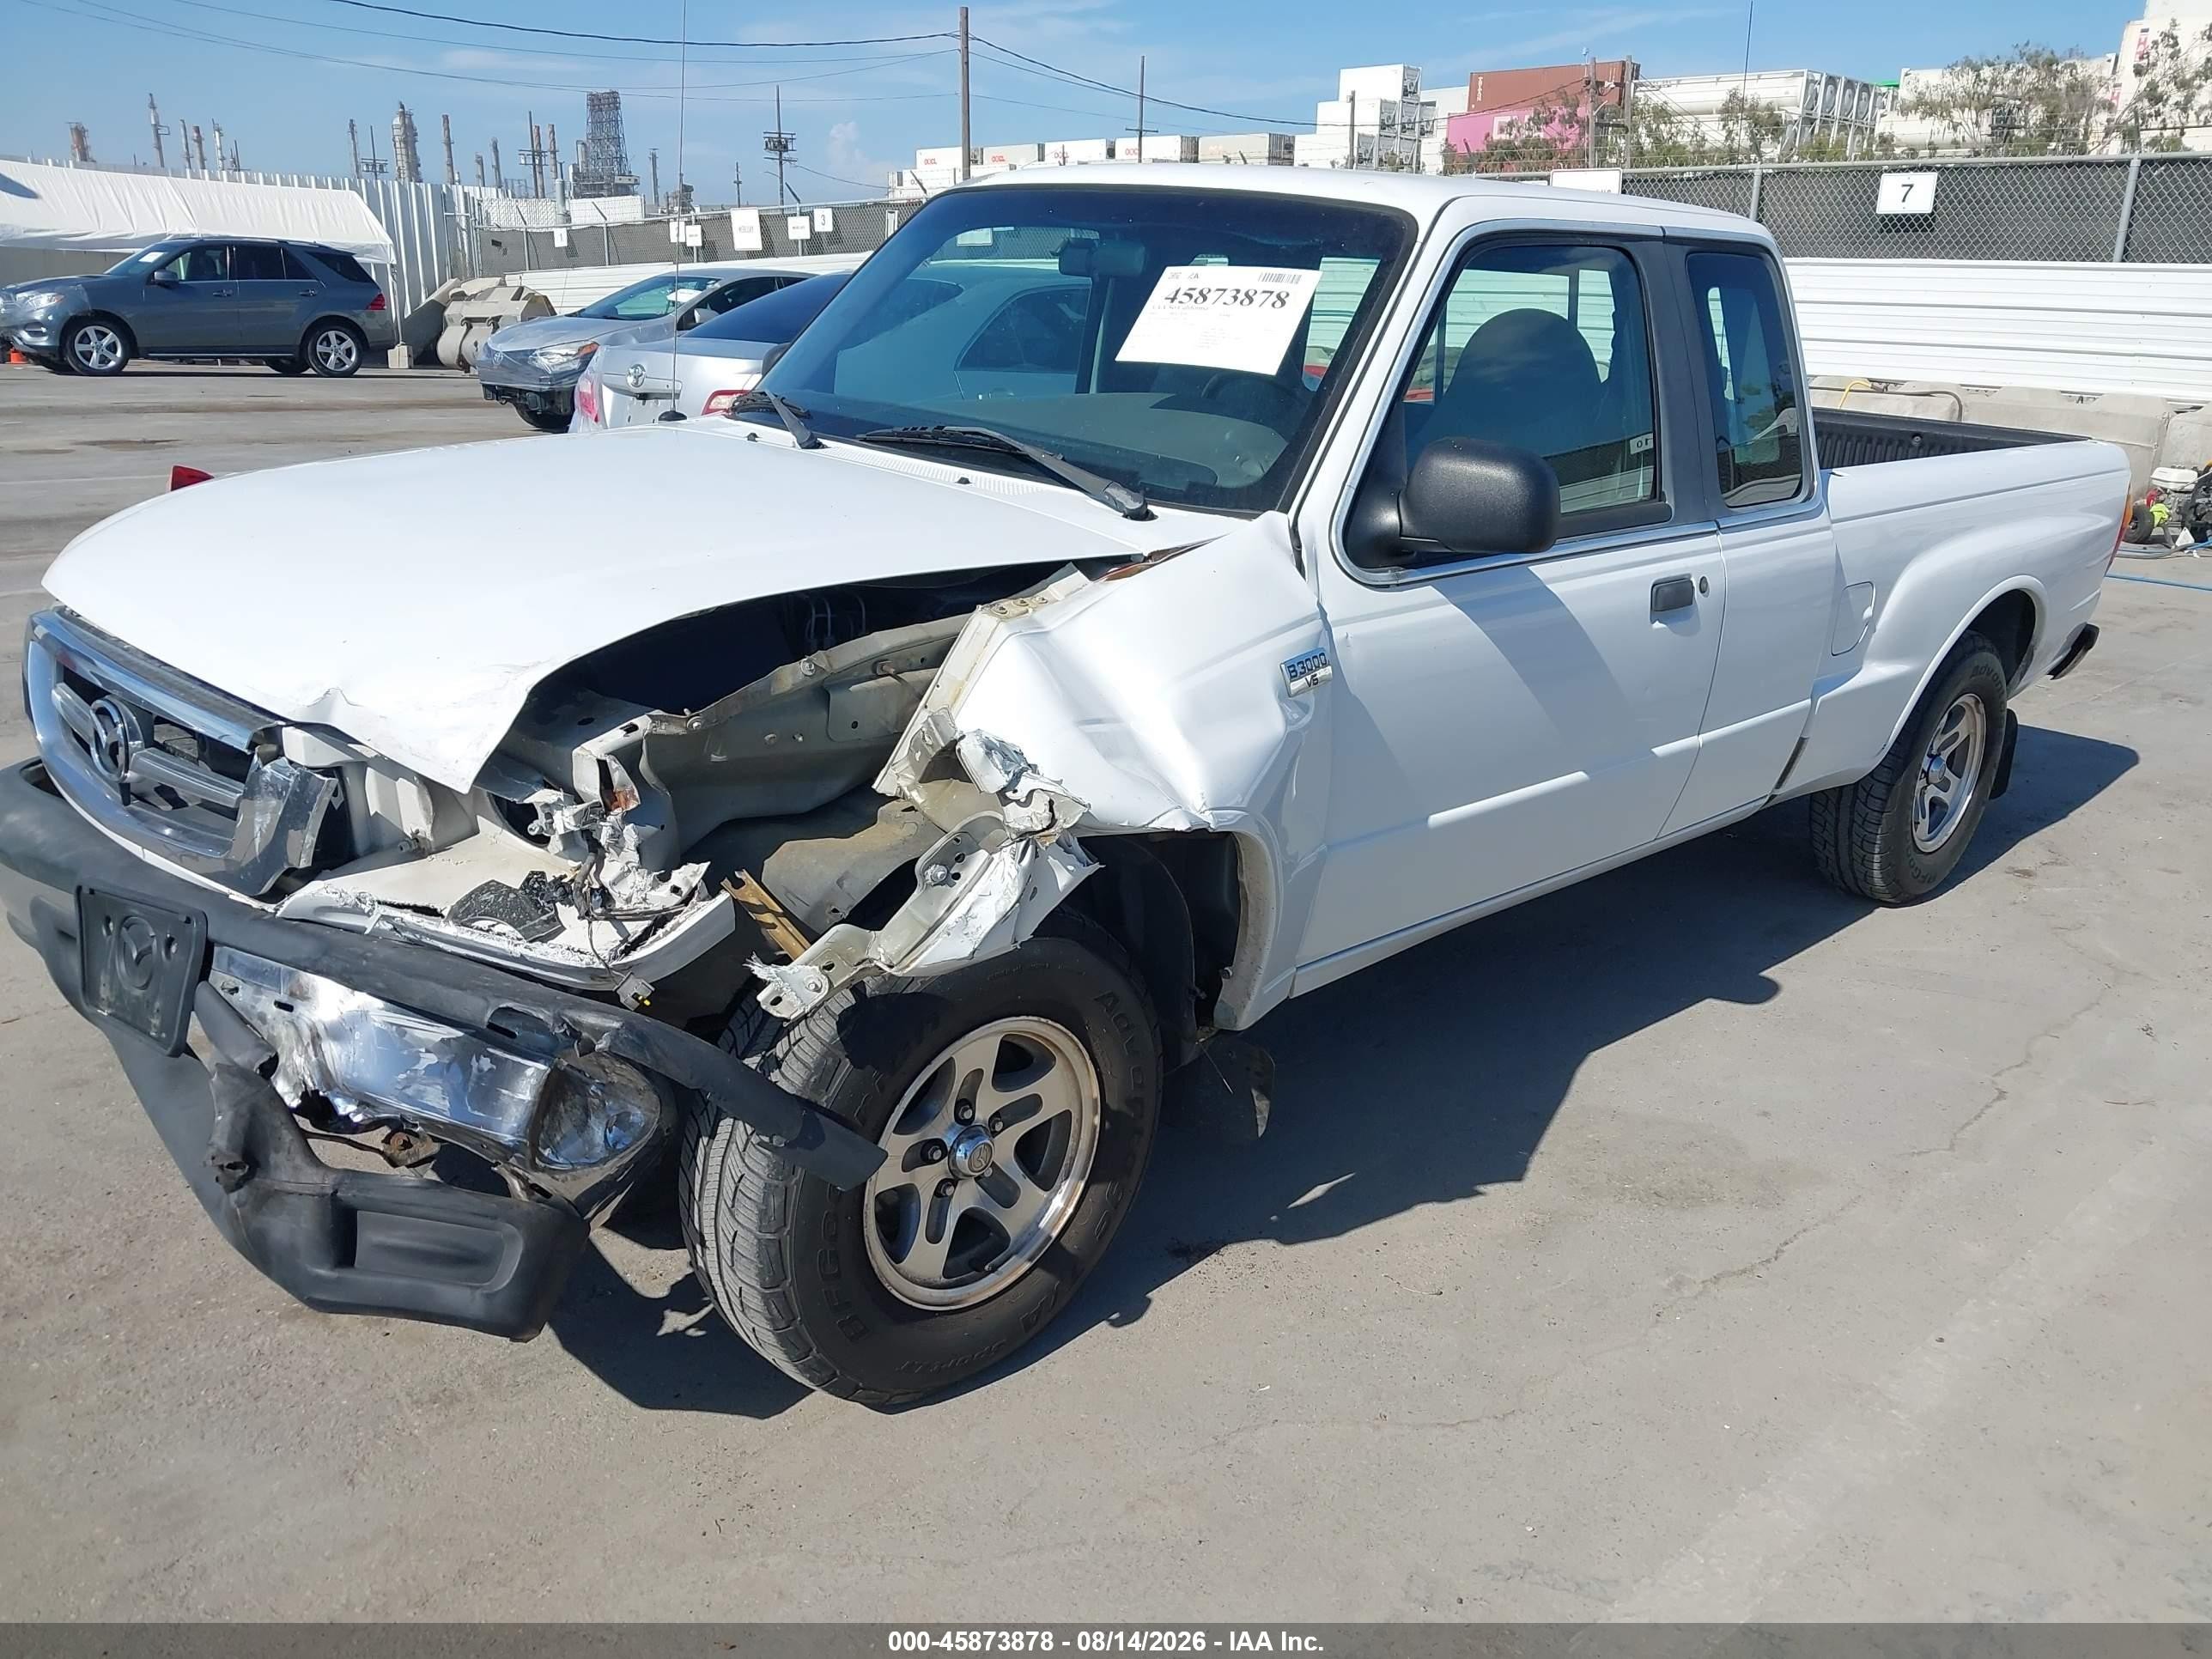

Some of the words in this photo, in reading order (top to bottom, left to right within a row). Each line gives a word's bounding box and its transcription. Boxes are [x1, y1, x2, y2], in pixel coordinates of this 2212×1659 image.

[1900, 183, 1915, 204] 7
[820, 214, 826, 226] 3
[1164, 286, 1290, 309] 45873878
[1287, 652, 1328, 679] B3000
[1305, 673, 1319, 688] V6
